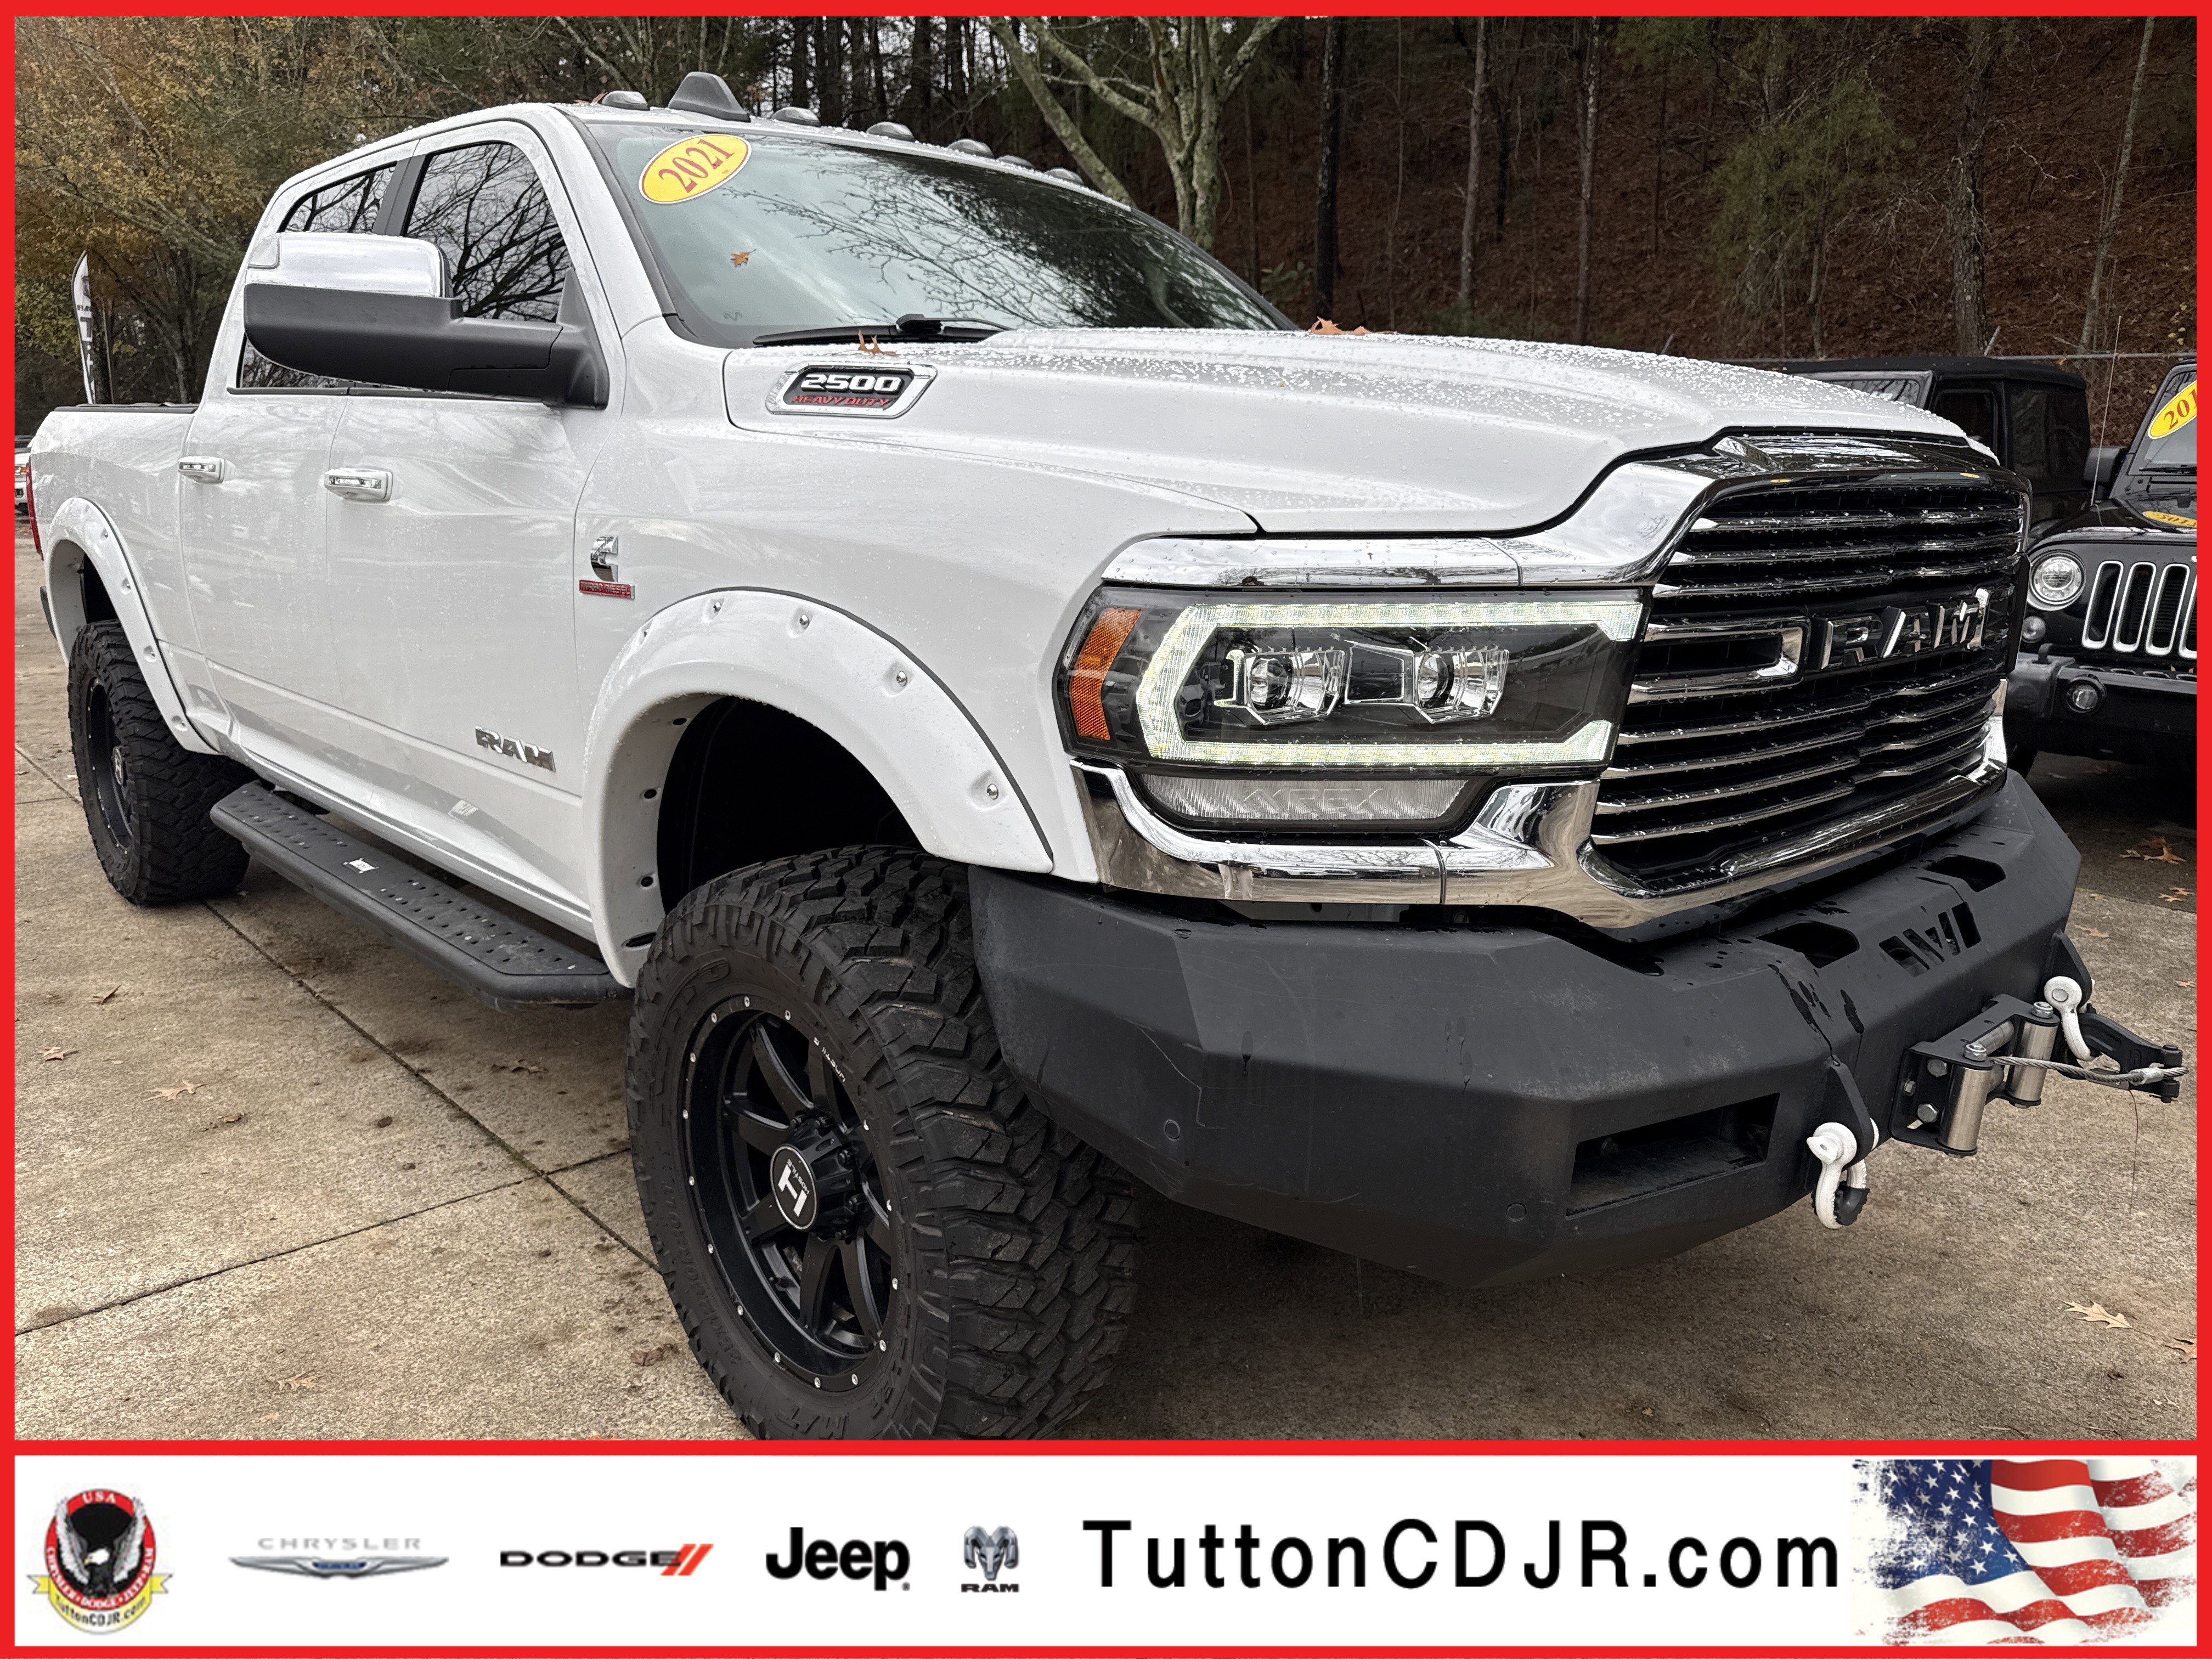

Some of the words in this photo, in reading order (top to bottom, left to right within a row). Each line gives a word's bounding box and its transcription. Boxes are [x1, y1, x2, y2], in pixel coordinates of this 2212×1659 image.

[658, 138, 735, 193] 2021
[792, 395, 845, 405] HEAVY
[843, 396, 891, 408] DUTY
[801, 374, 904, 395] 2500
[1813, 588, 1990, 670] RAM
[475, 726, 556, 772] RAM
